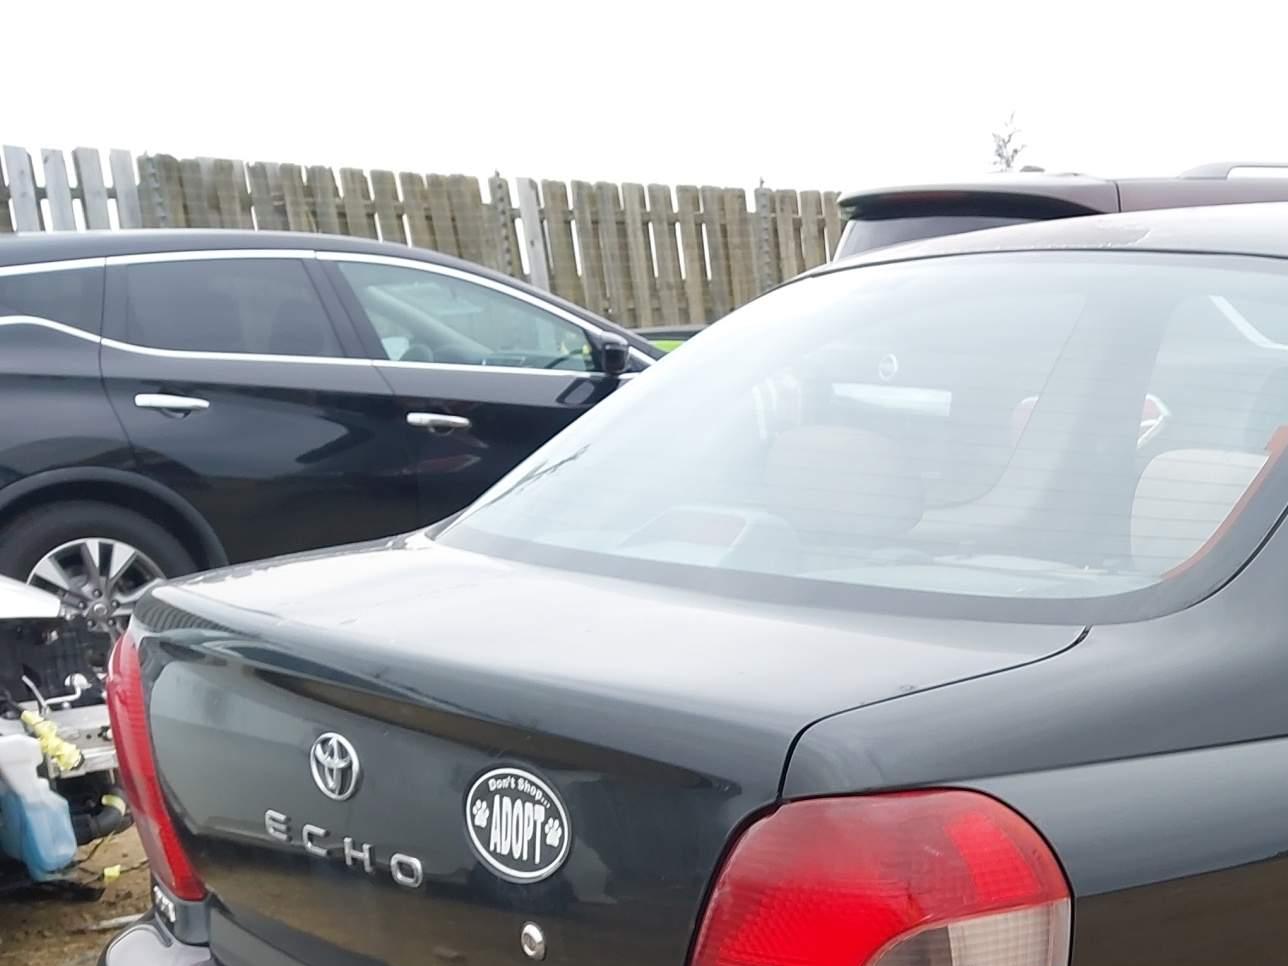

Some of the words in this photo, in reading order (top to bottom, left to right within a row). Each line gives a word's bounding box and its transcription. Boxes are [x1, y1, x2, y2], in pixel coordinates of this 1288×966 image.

[488, 776, 515, 791] Don't
[517, 777, 550, 808] Shop...
[264, 809, 423, 888] ECHO
[489, 794, 545, 864] ADOPT
